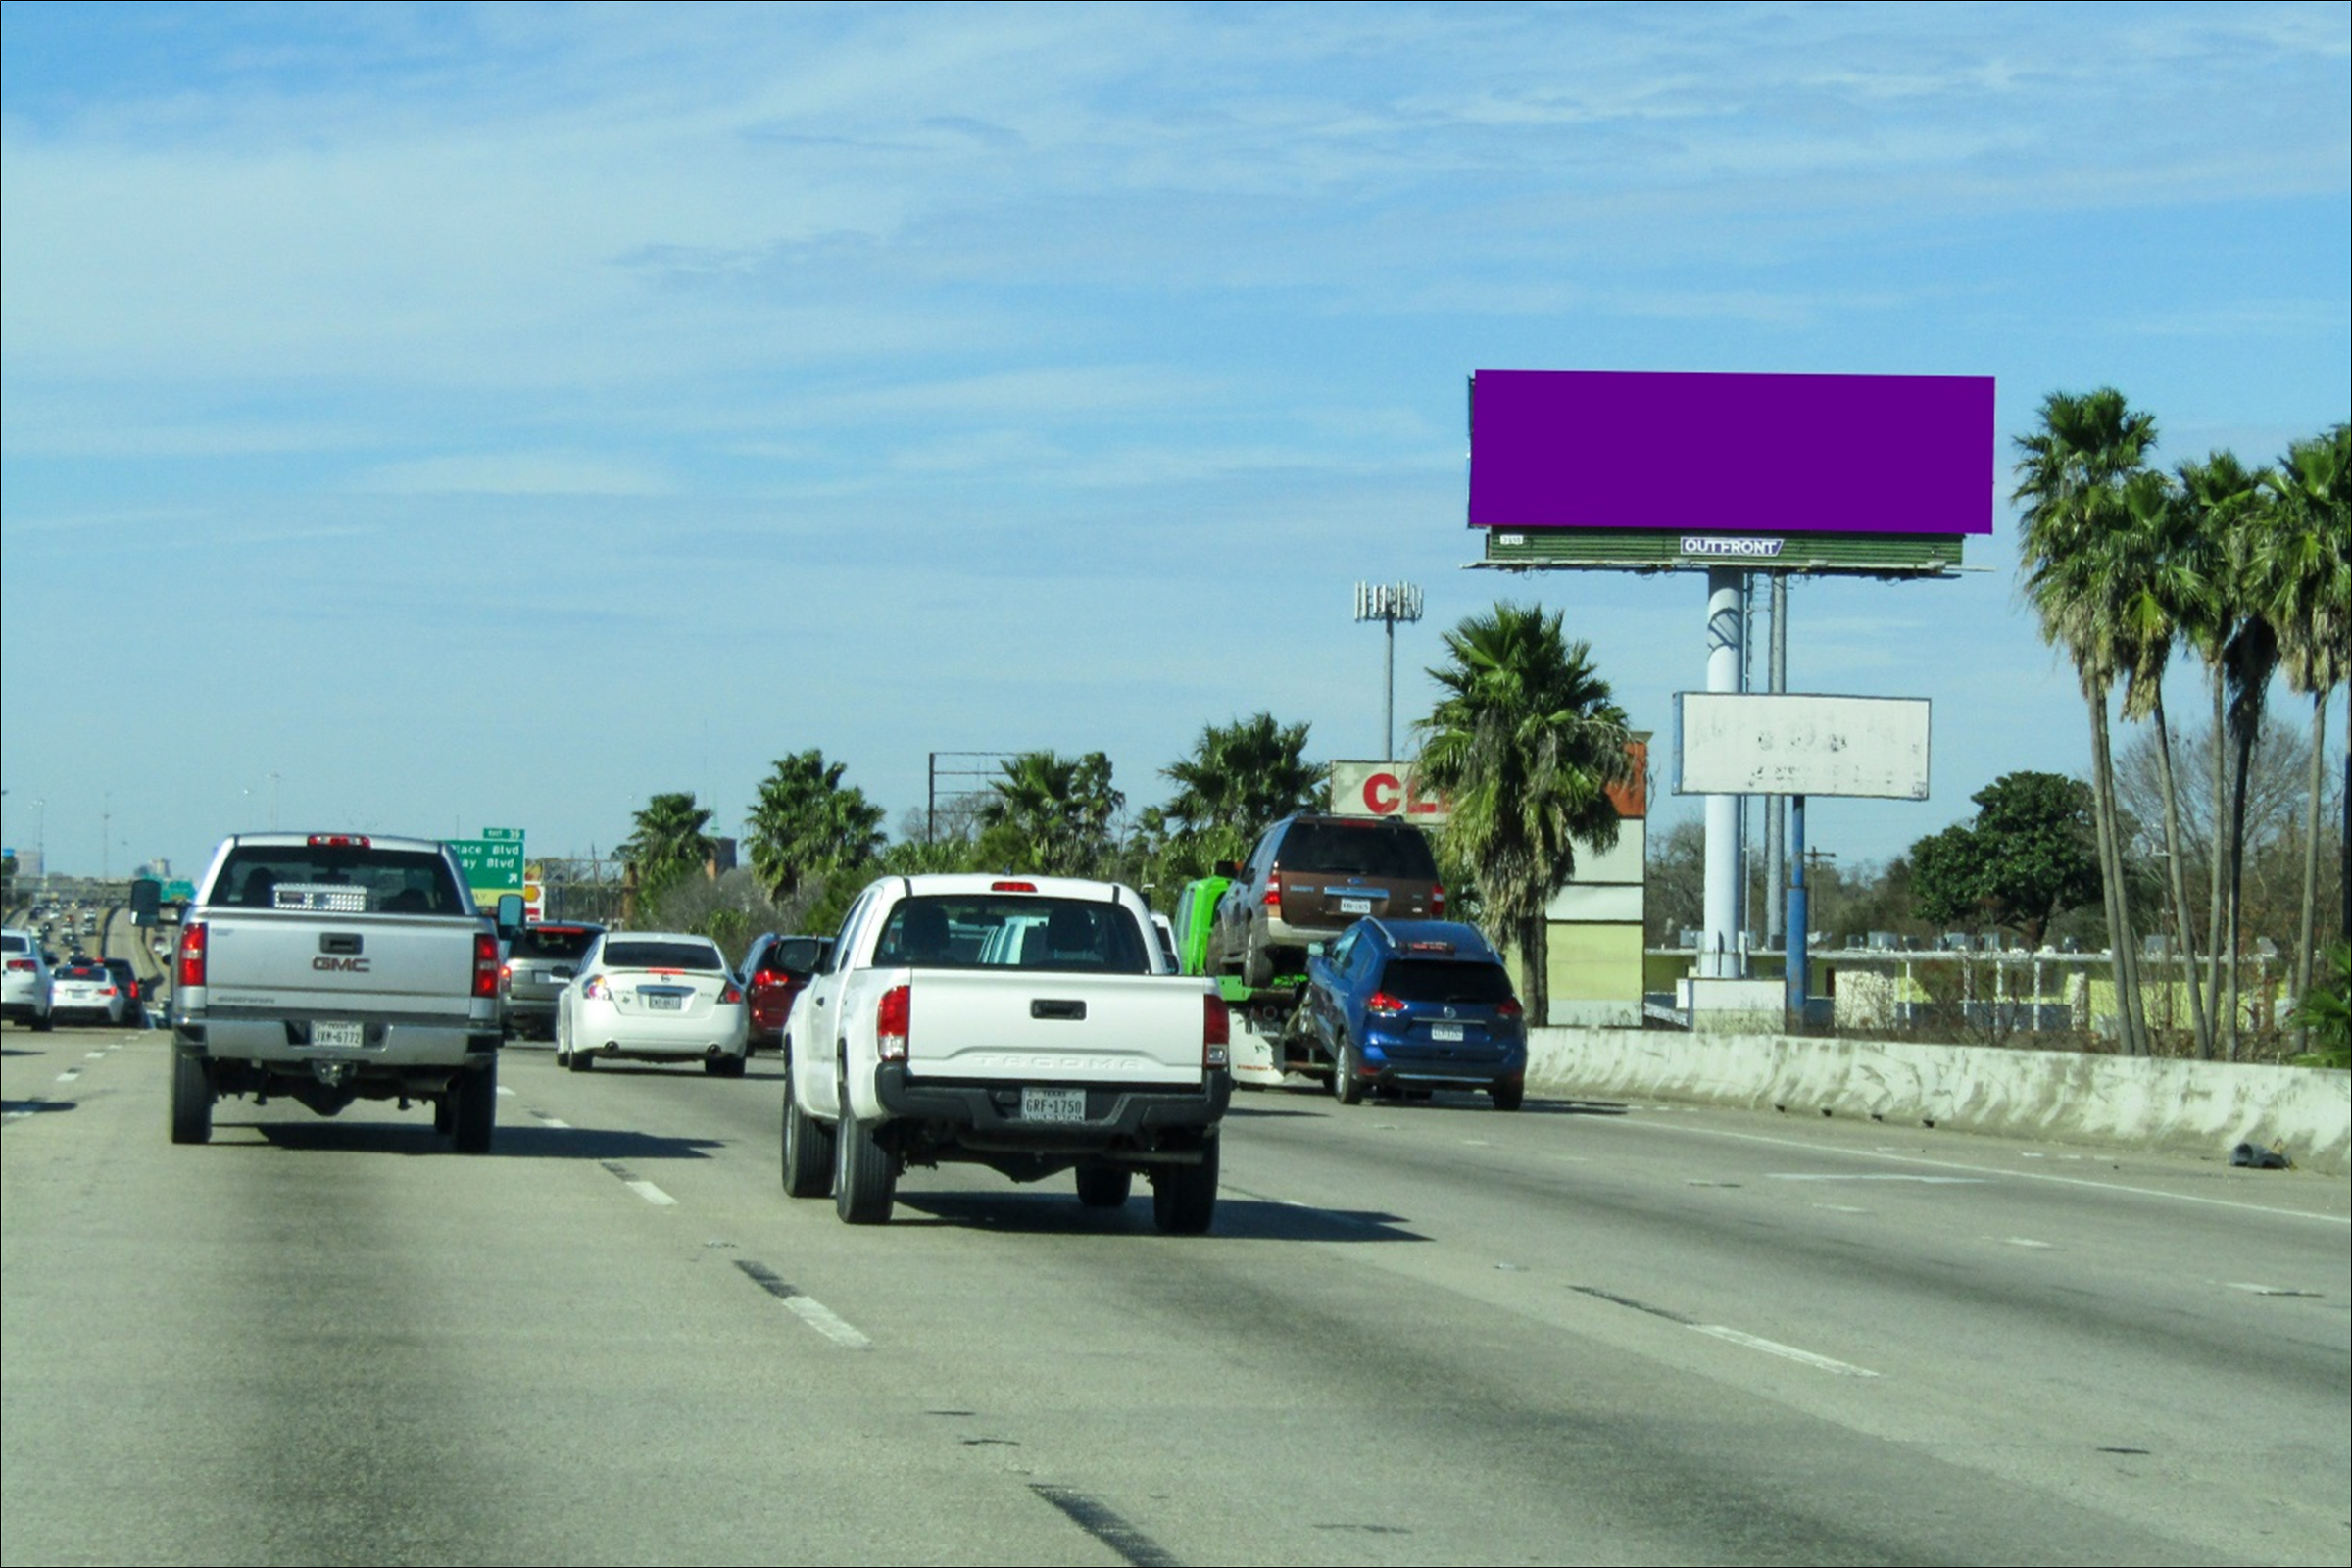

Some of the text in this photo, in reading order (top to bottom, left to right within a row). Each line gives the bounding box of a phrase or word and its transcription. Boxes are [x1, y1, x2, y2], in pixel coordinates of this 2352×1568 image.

[1685, 540, 1778, 555] OUTFRONT
[492, 845, 520, 856] Blvd
[486, 858, 515, 869] Blvd
[312, 956, 371, 973] GMC
[974, 1054, 1144, 1071] TACOMA
